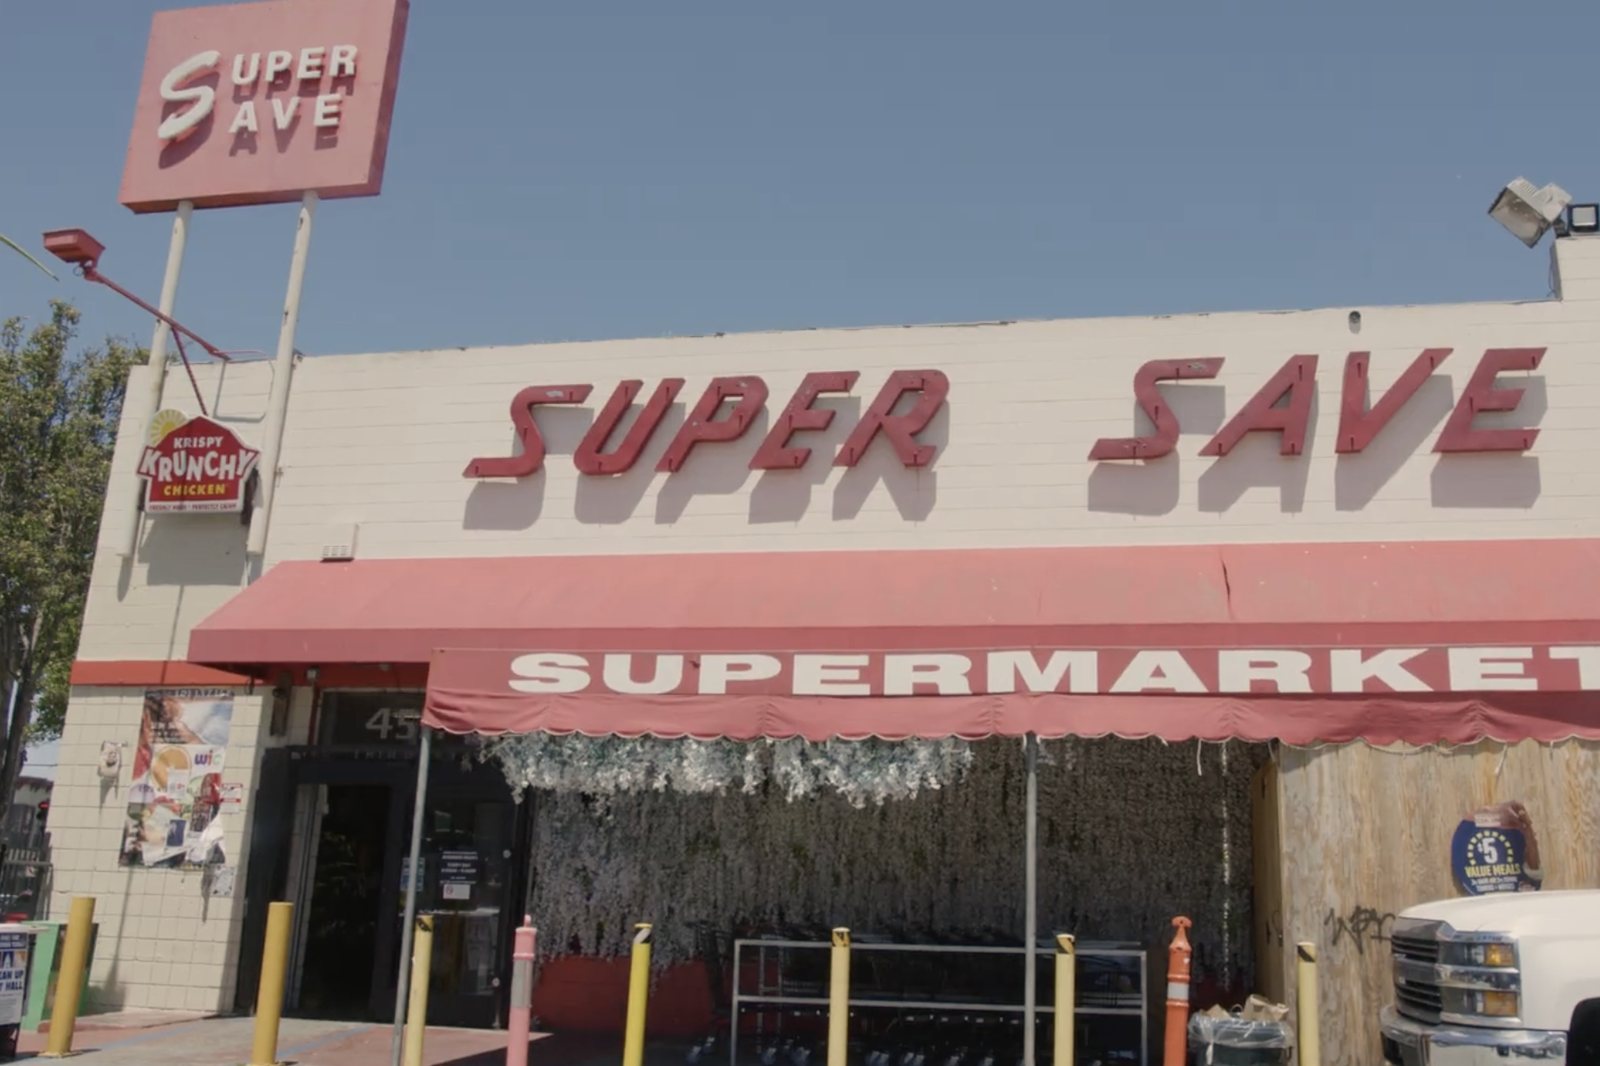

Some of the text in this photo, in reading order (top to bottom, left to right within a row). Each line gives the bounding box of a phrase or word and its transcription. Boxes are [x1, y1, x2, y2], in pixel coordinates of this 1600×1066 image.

[463, 347, 1548, 479] SUPER SAVE
[173, 436, 224, 449] KRISPY
[139, 447, 257, 482] KRUNCHY
[163, 483, 226, 496] CHICKEN
[508, 646, 1600, 696] SUPERMARKET
[1464, 863, 1520, 878] VALUE MEALS
